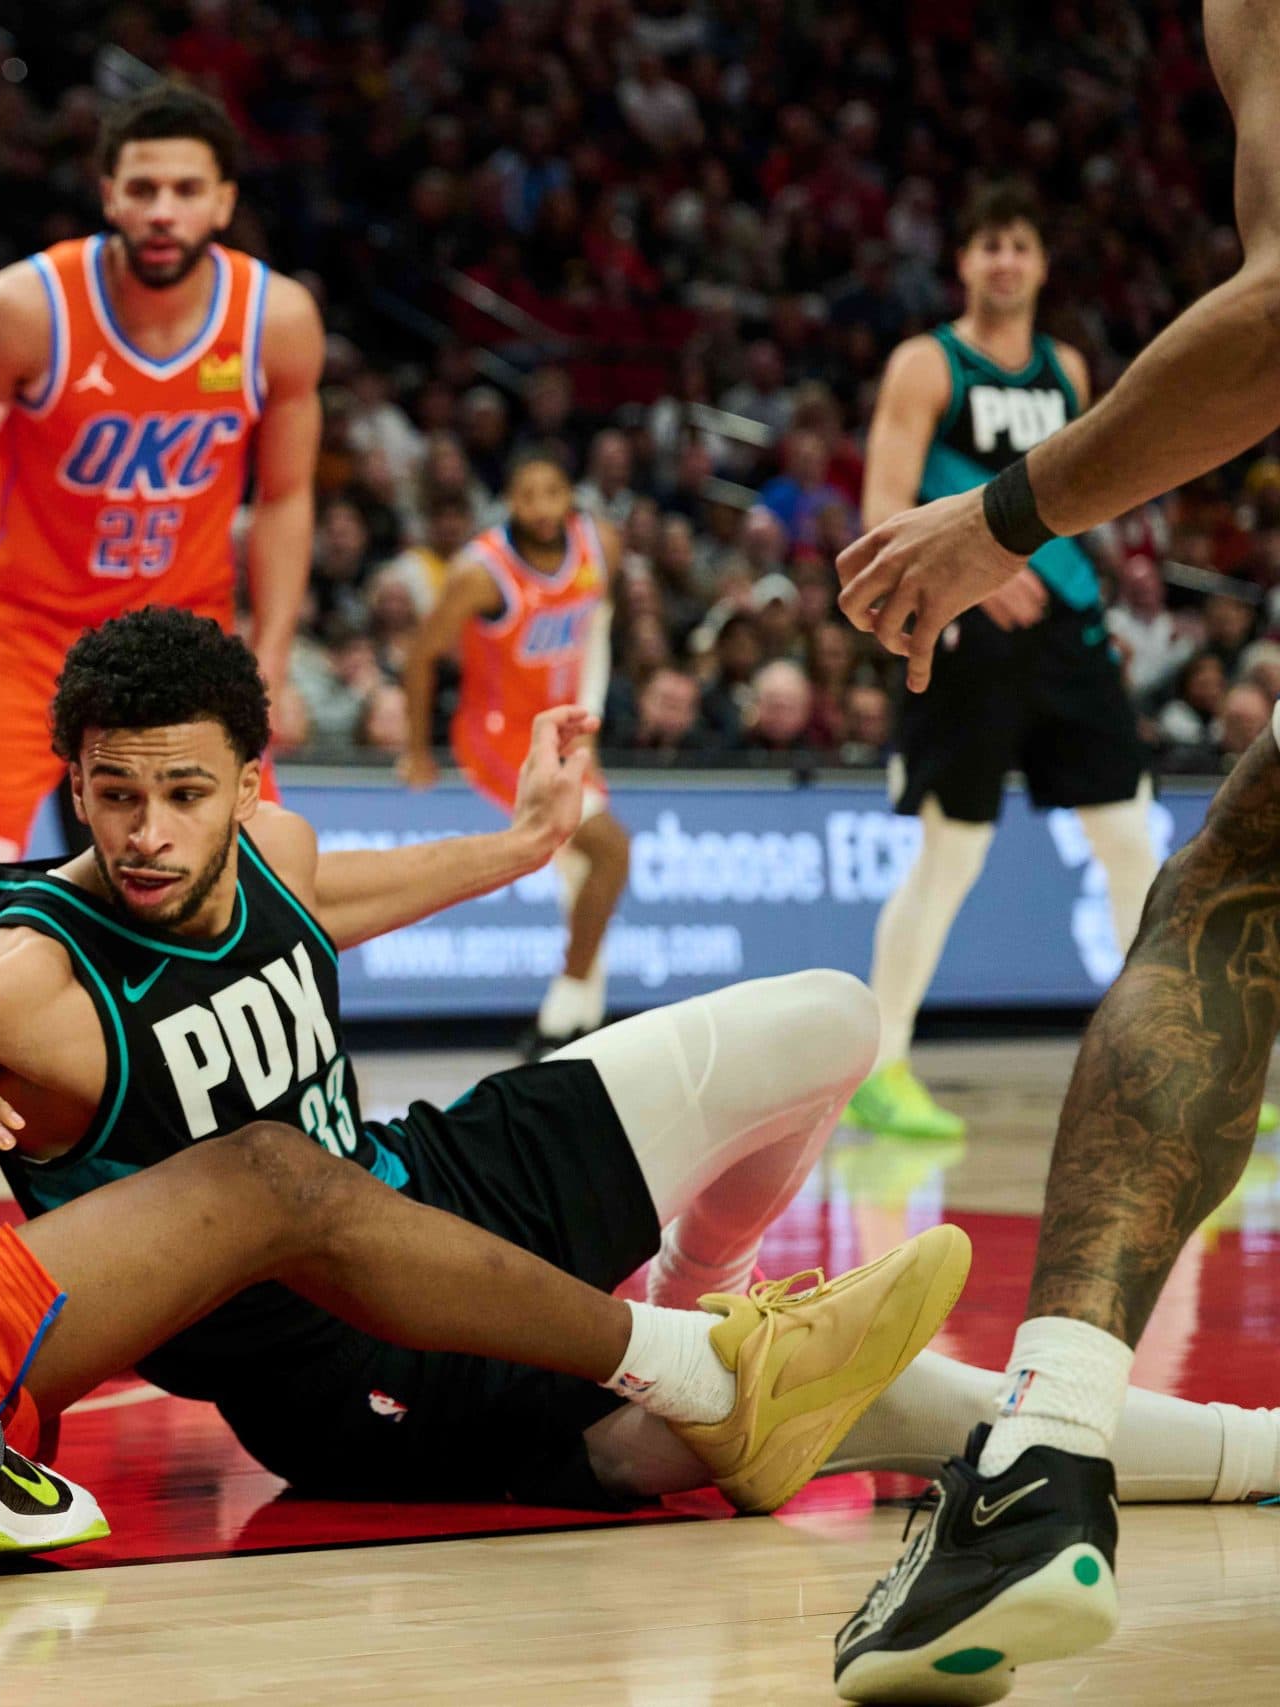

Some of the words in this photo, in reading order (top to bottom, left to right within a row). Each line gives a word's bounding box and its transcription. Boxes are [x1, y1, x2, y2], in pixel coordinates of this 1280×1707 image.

[57, 410, 245, 501] OKC
[969, 384, 1068, 453] PDX
[89, 505, 185, 580] 25
[152, 941, 337, 1140] PDX
[299, 1056, 358, 1158] 33
